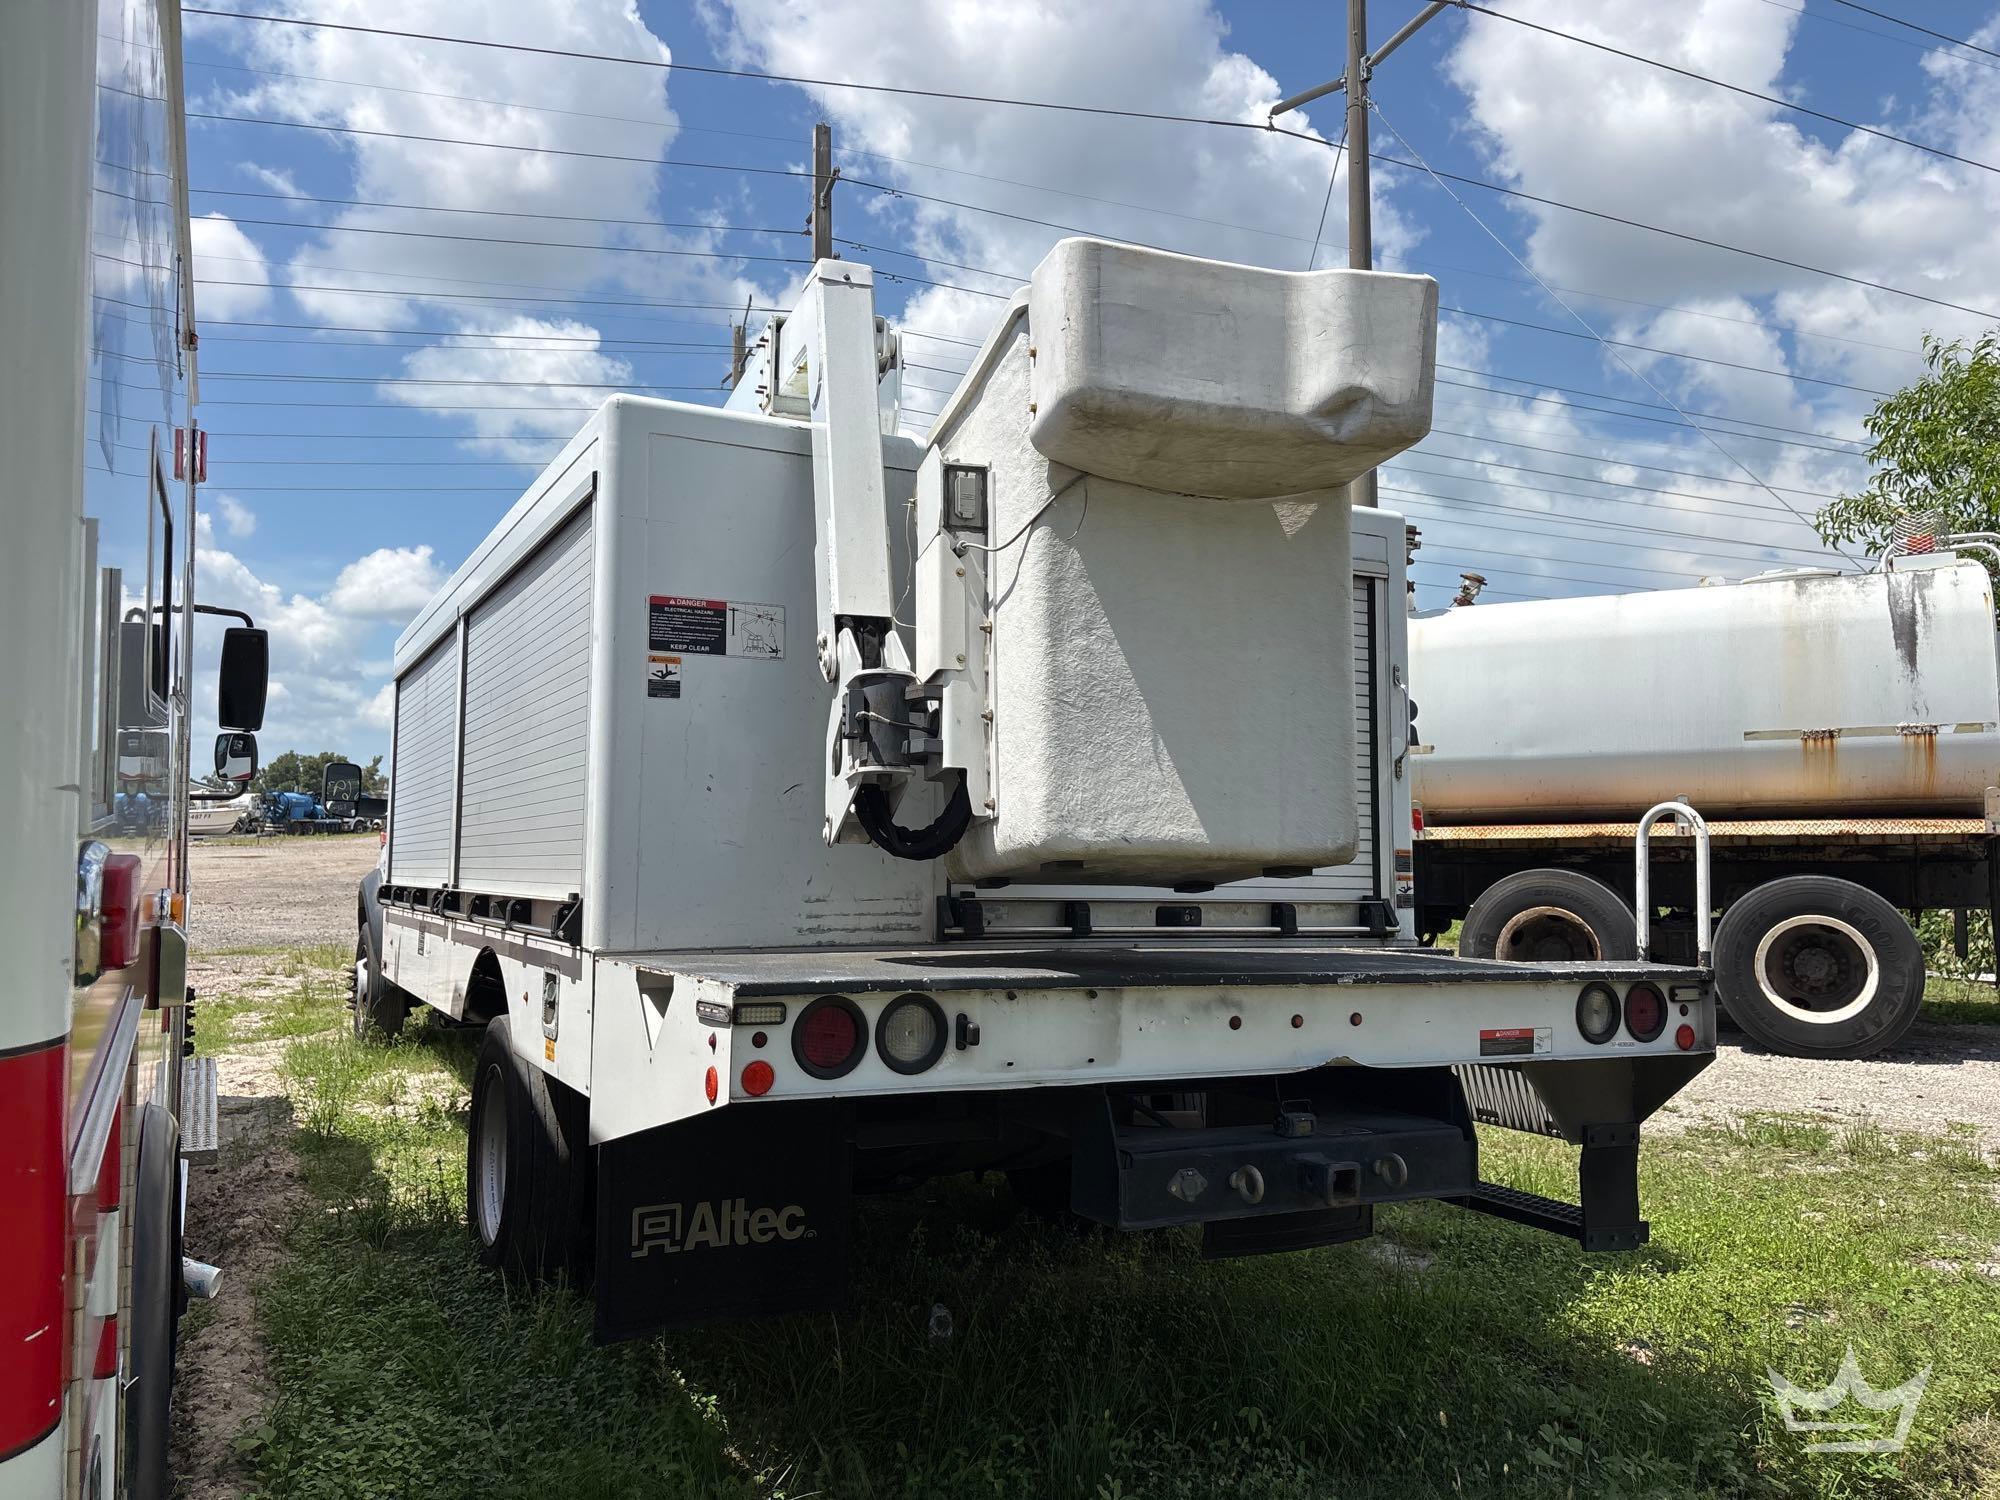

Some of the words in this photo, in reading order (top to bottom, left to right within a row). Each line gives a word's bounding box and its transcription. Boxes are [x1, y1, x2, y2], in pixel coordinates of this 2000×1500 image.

[676, 599, 707, 607] DANGER
[664, 606, 694, 614] ELECTRICAL
[670, 643, 688, 651] KEEP
[683, 1198, 805, 1250] Altec
